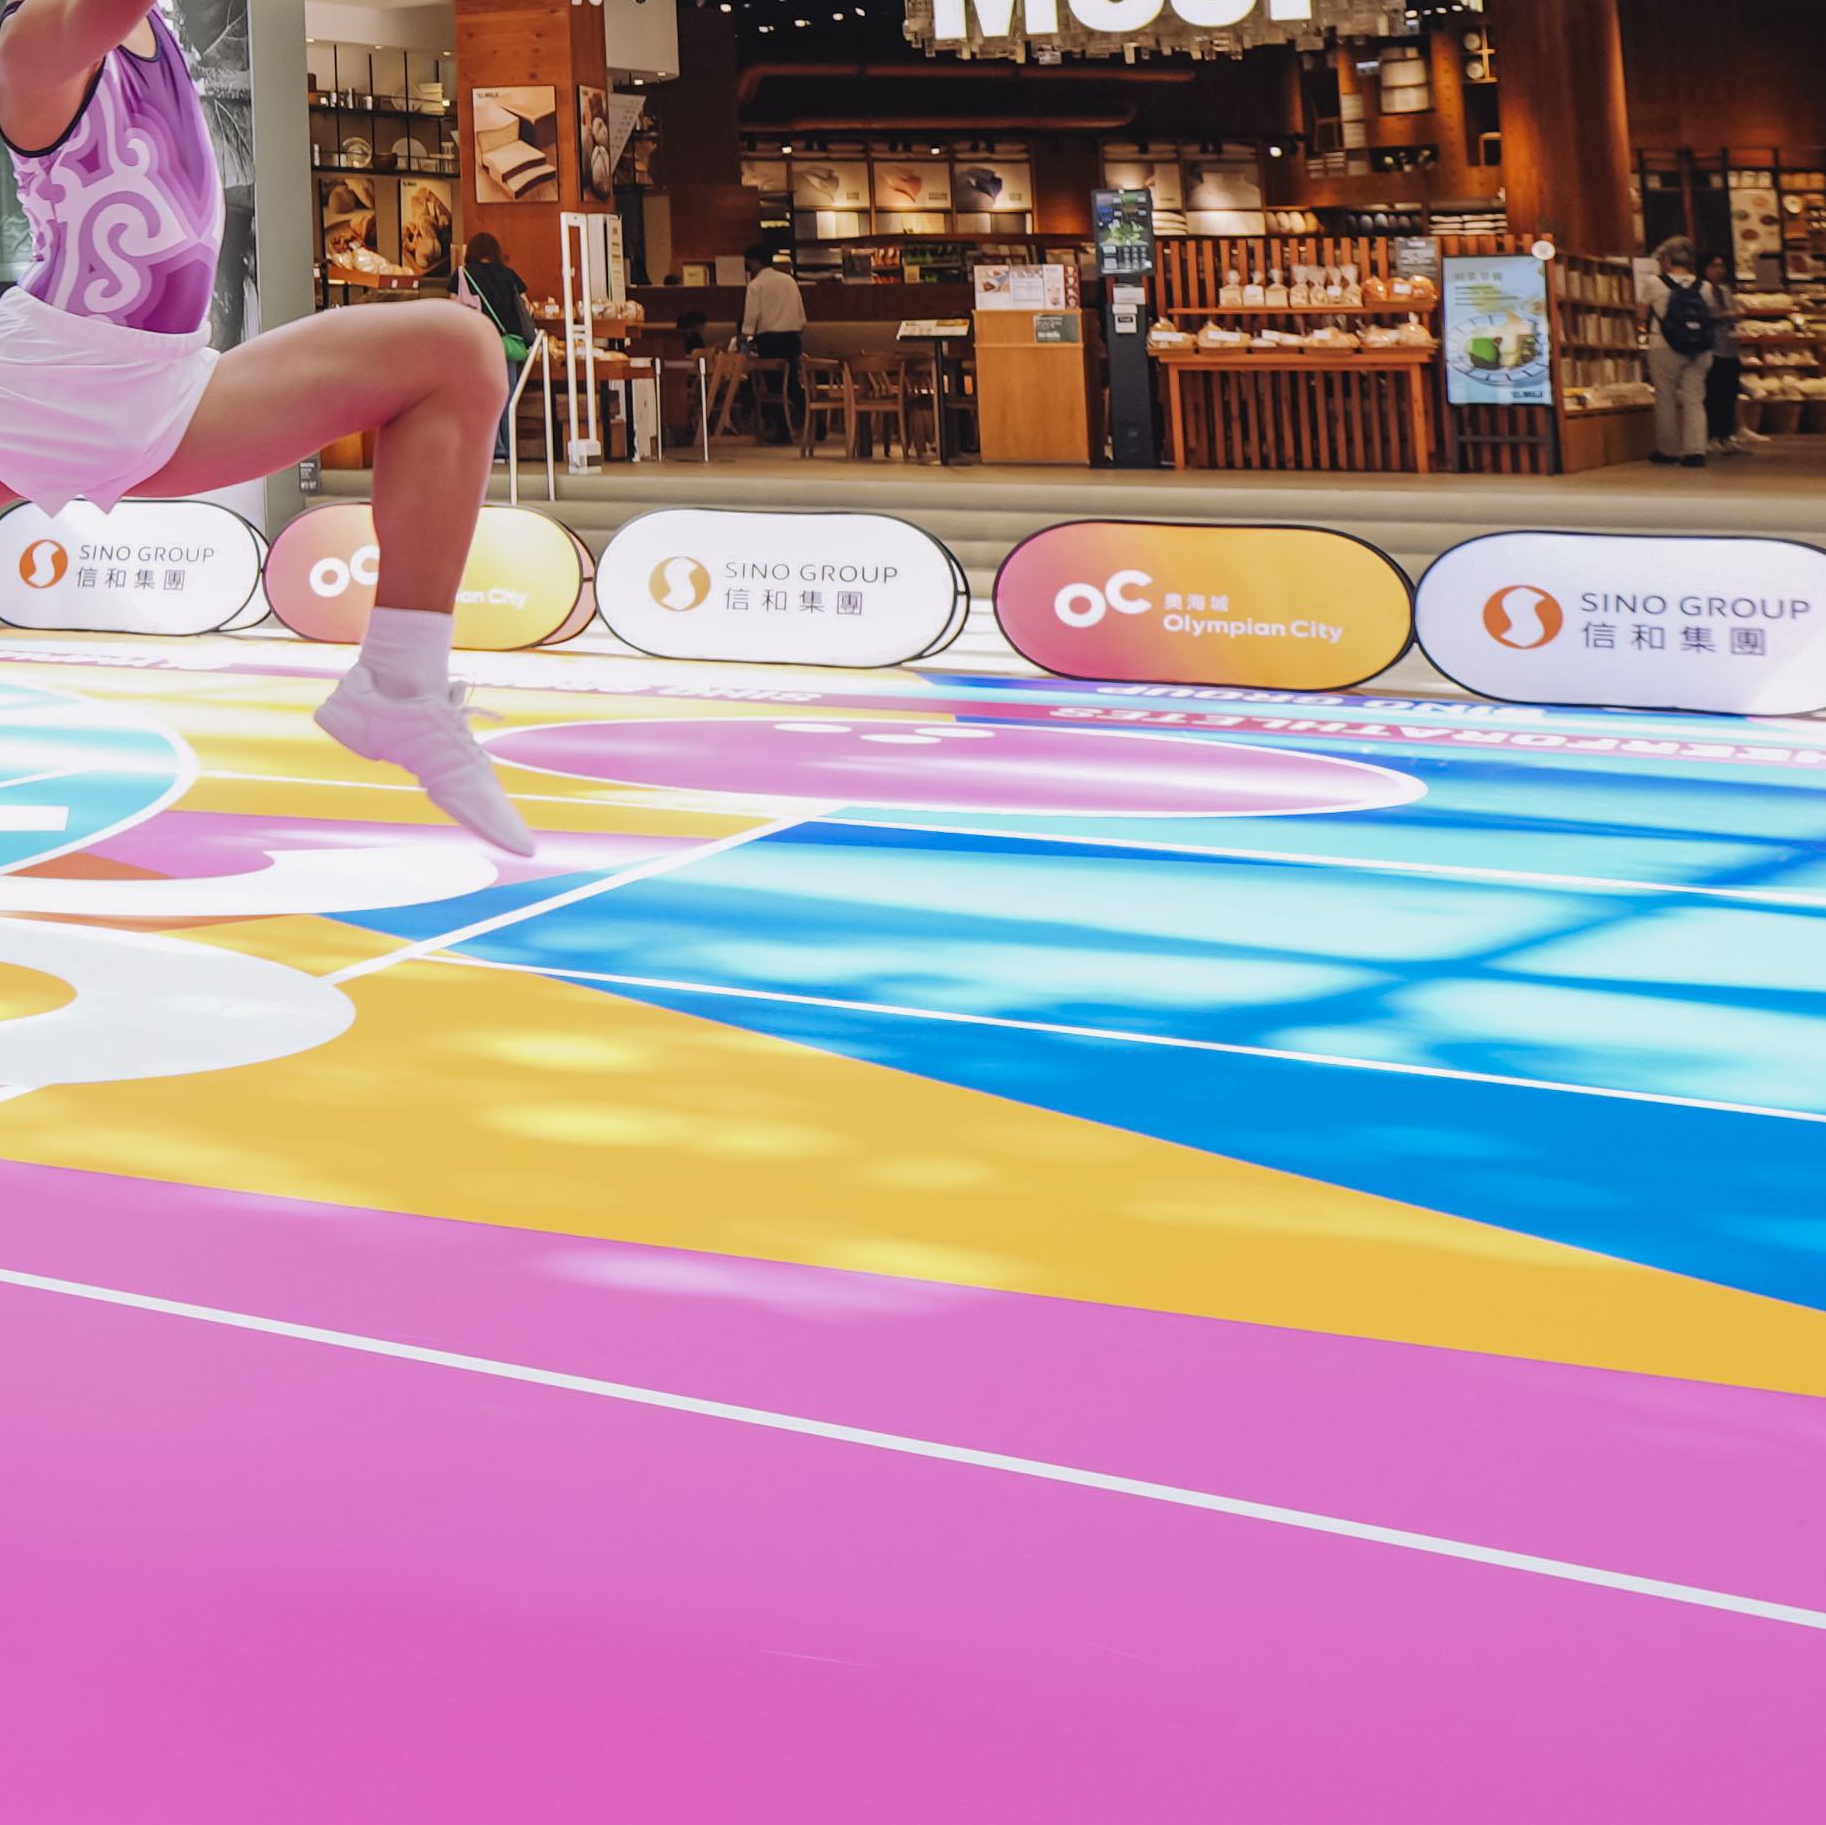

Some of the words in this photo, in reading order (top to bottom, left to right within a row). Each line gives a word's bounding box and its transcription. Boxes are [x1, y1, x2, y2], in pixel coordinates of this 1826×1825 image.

[79, 544, 131, 561] SINO
[138, 546, 215, 563] GROUP
[77, 567, 185, 591] 信和集團
[725, 562, 790, 581] SINO
[800, 564, 898, 584] GROUP
[489, 587, 527, 609] City
[725, 589, 863, 615] 信和集團
[1054, 570, 1153, 628] OC
[1581, 592, 1667, 615] SINO
[1680, 596, 1810, 620] GROUP
[1163, 614, 1287, 638] Olympian
[1290, 620, 1343, 643] City
[1582, 622, 1765, 656] 信和集團
[1097, 685, 1343, 705] GROUP
